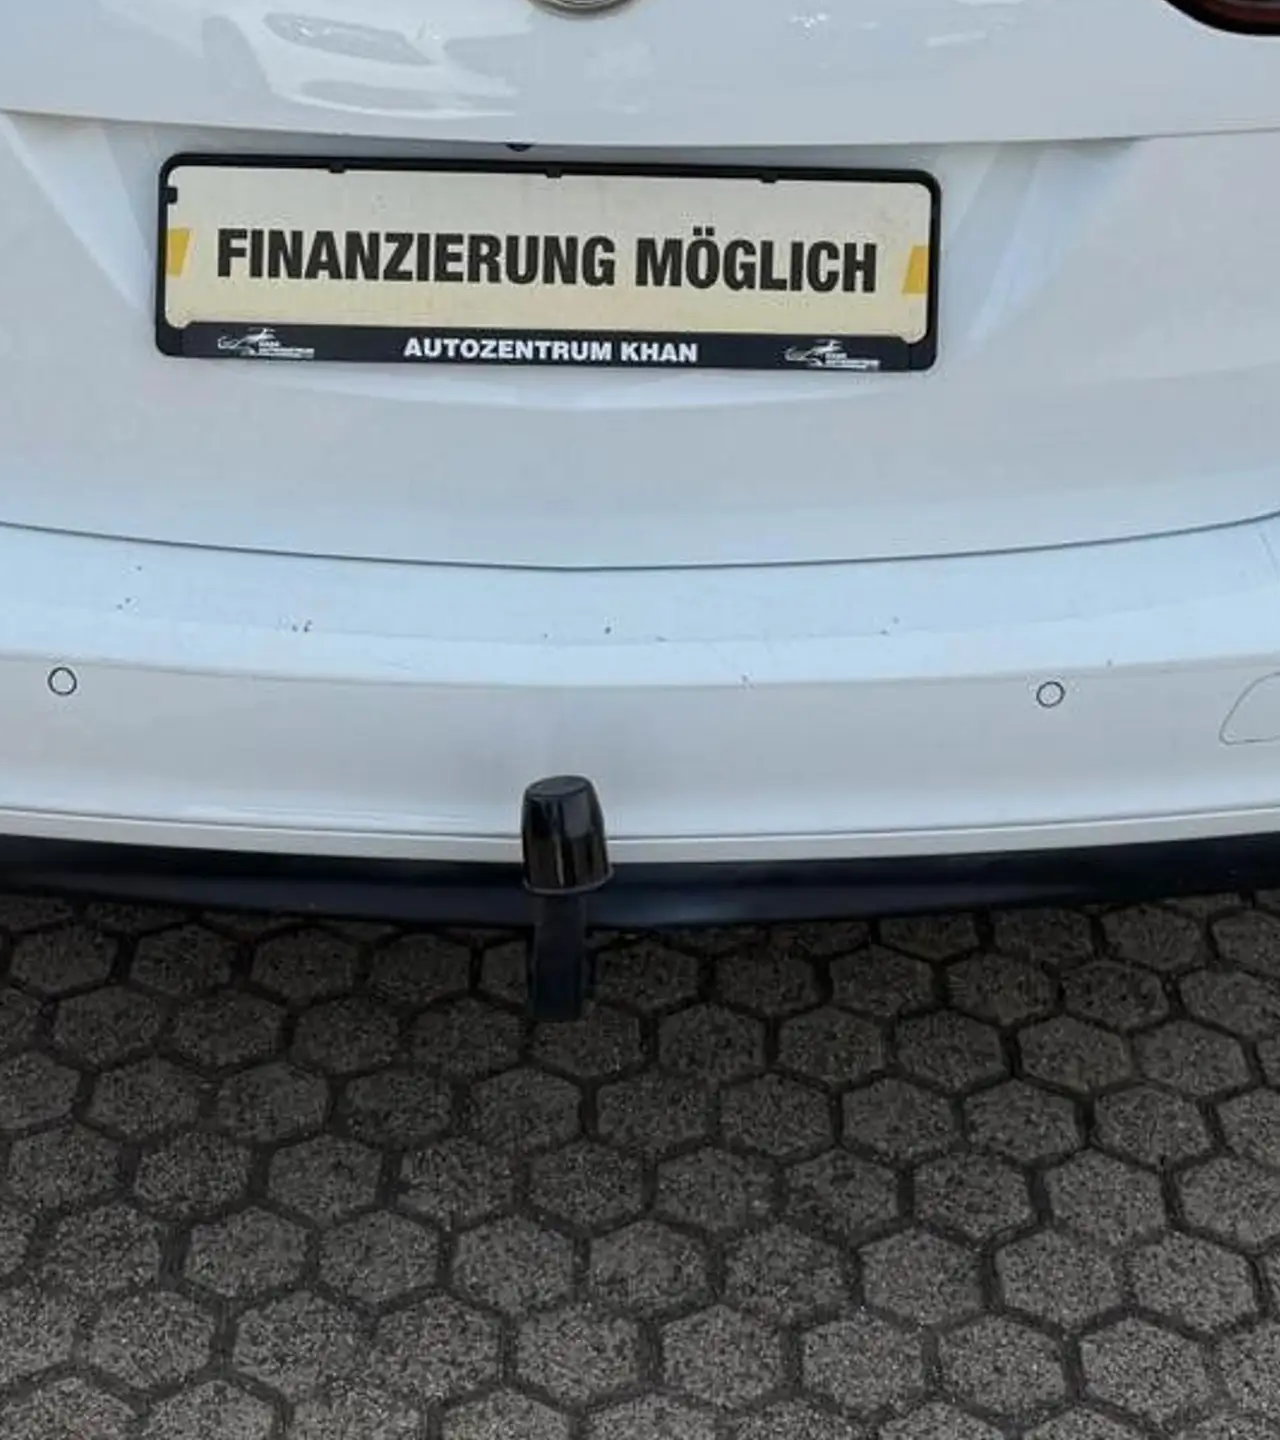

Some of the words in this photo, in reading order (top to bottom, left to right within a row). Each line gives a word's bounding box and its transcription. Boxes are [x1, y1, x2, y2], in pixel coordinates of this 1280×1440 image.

[216, 228, 616, 286] FINANZIERUNG
[634, 225, 878, 293] MÖGLICH
[404, 336, 612, 362] AUTOZENTRUM
[620, 341, 699, 363] KHAN
